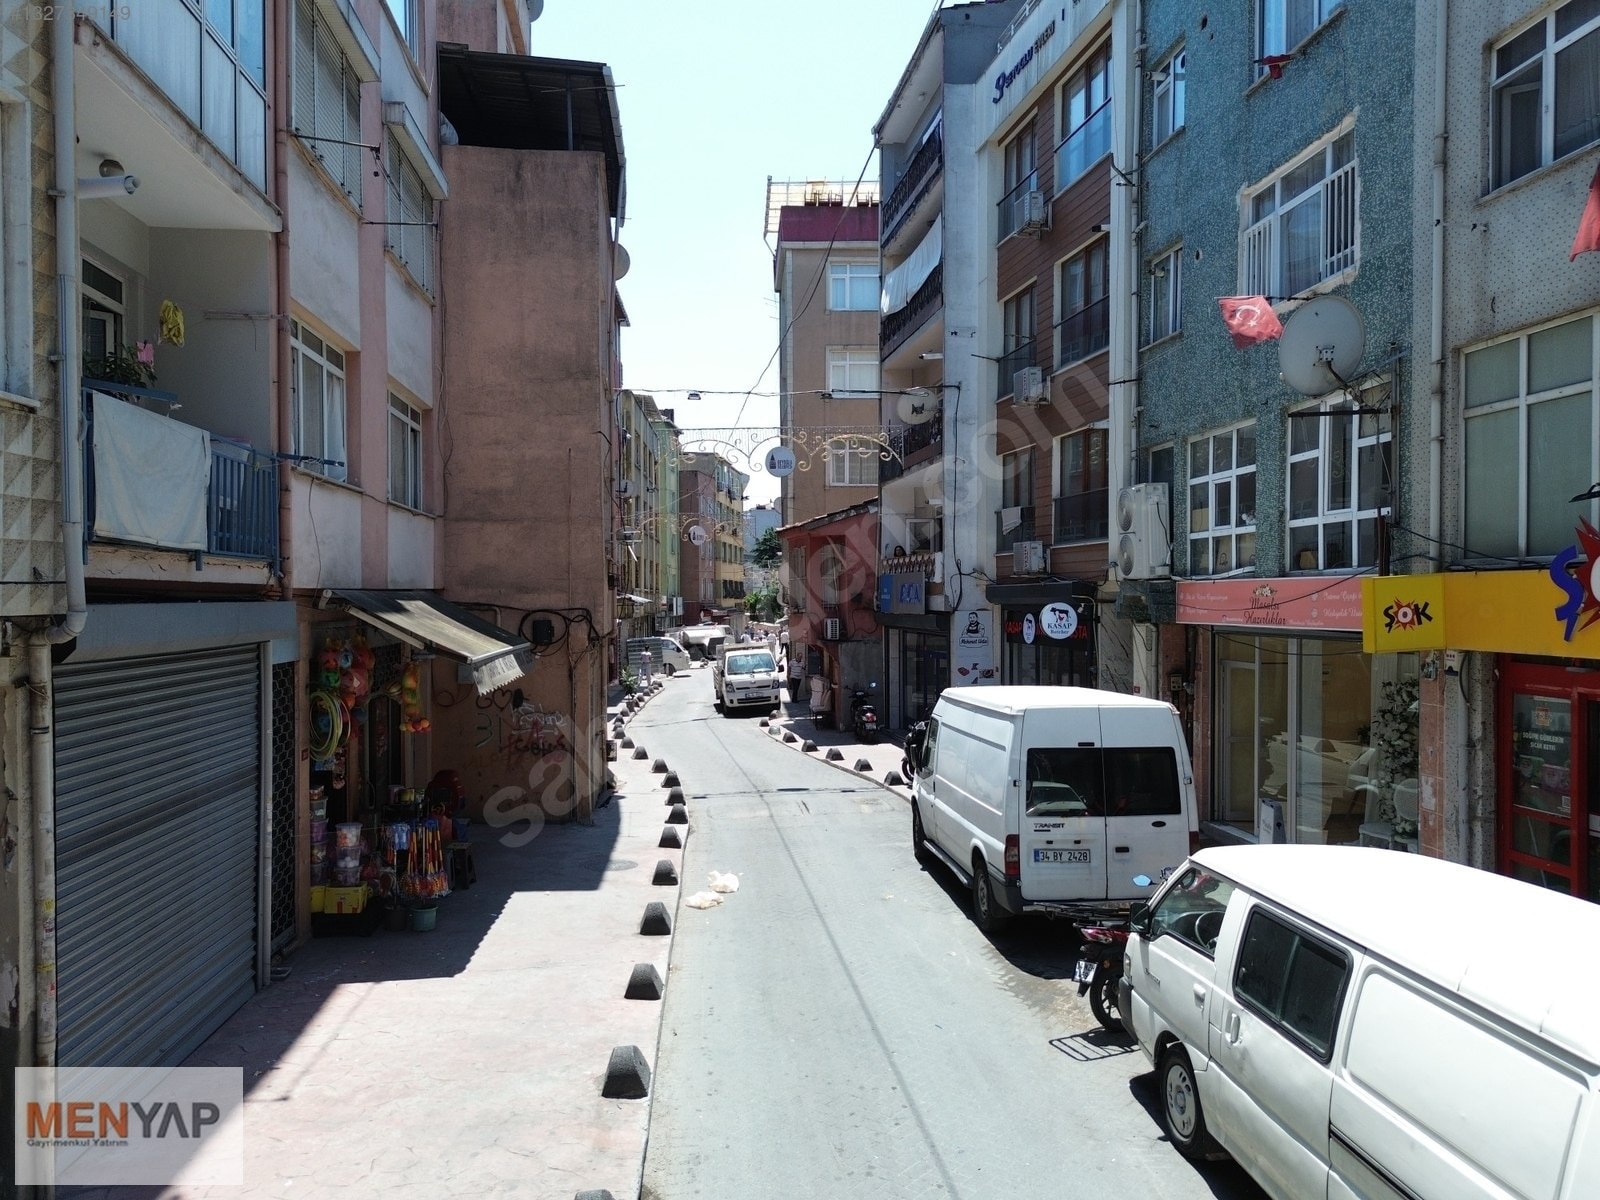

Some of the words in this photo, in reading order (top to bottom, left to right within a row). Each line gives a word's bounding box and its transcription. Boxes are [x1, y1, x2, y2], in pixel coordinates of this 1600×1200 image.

[1383, 601, 1434, 633] ŞOK
[1047, 622, 1073, 630] KASAP
[1040, 850, 1050, 862] 34
[1053, 850, 1063, 862] BY
[1068, 850, 1088, 862] 2428
